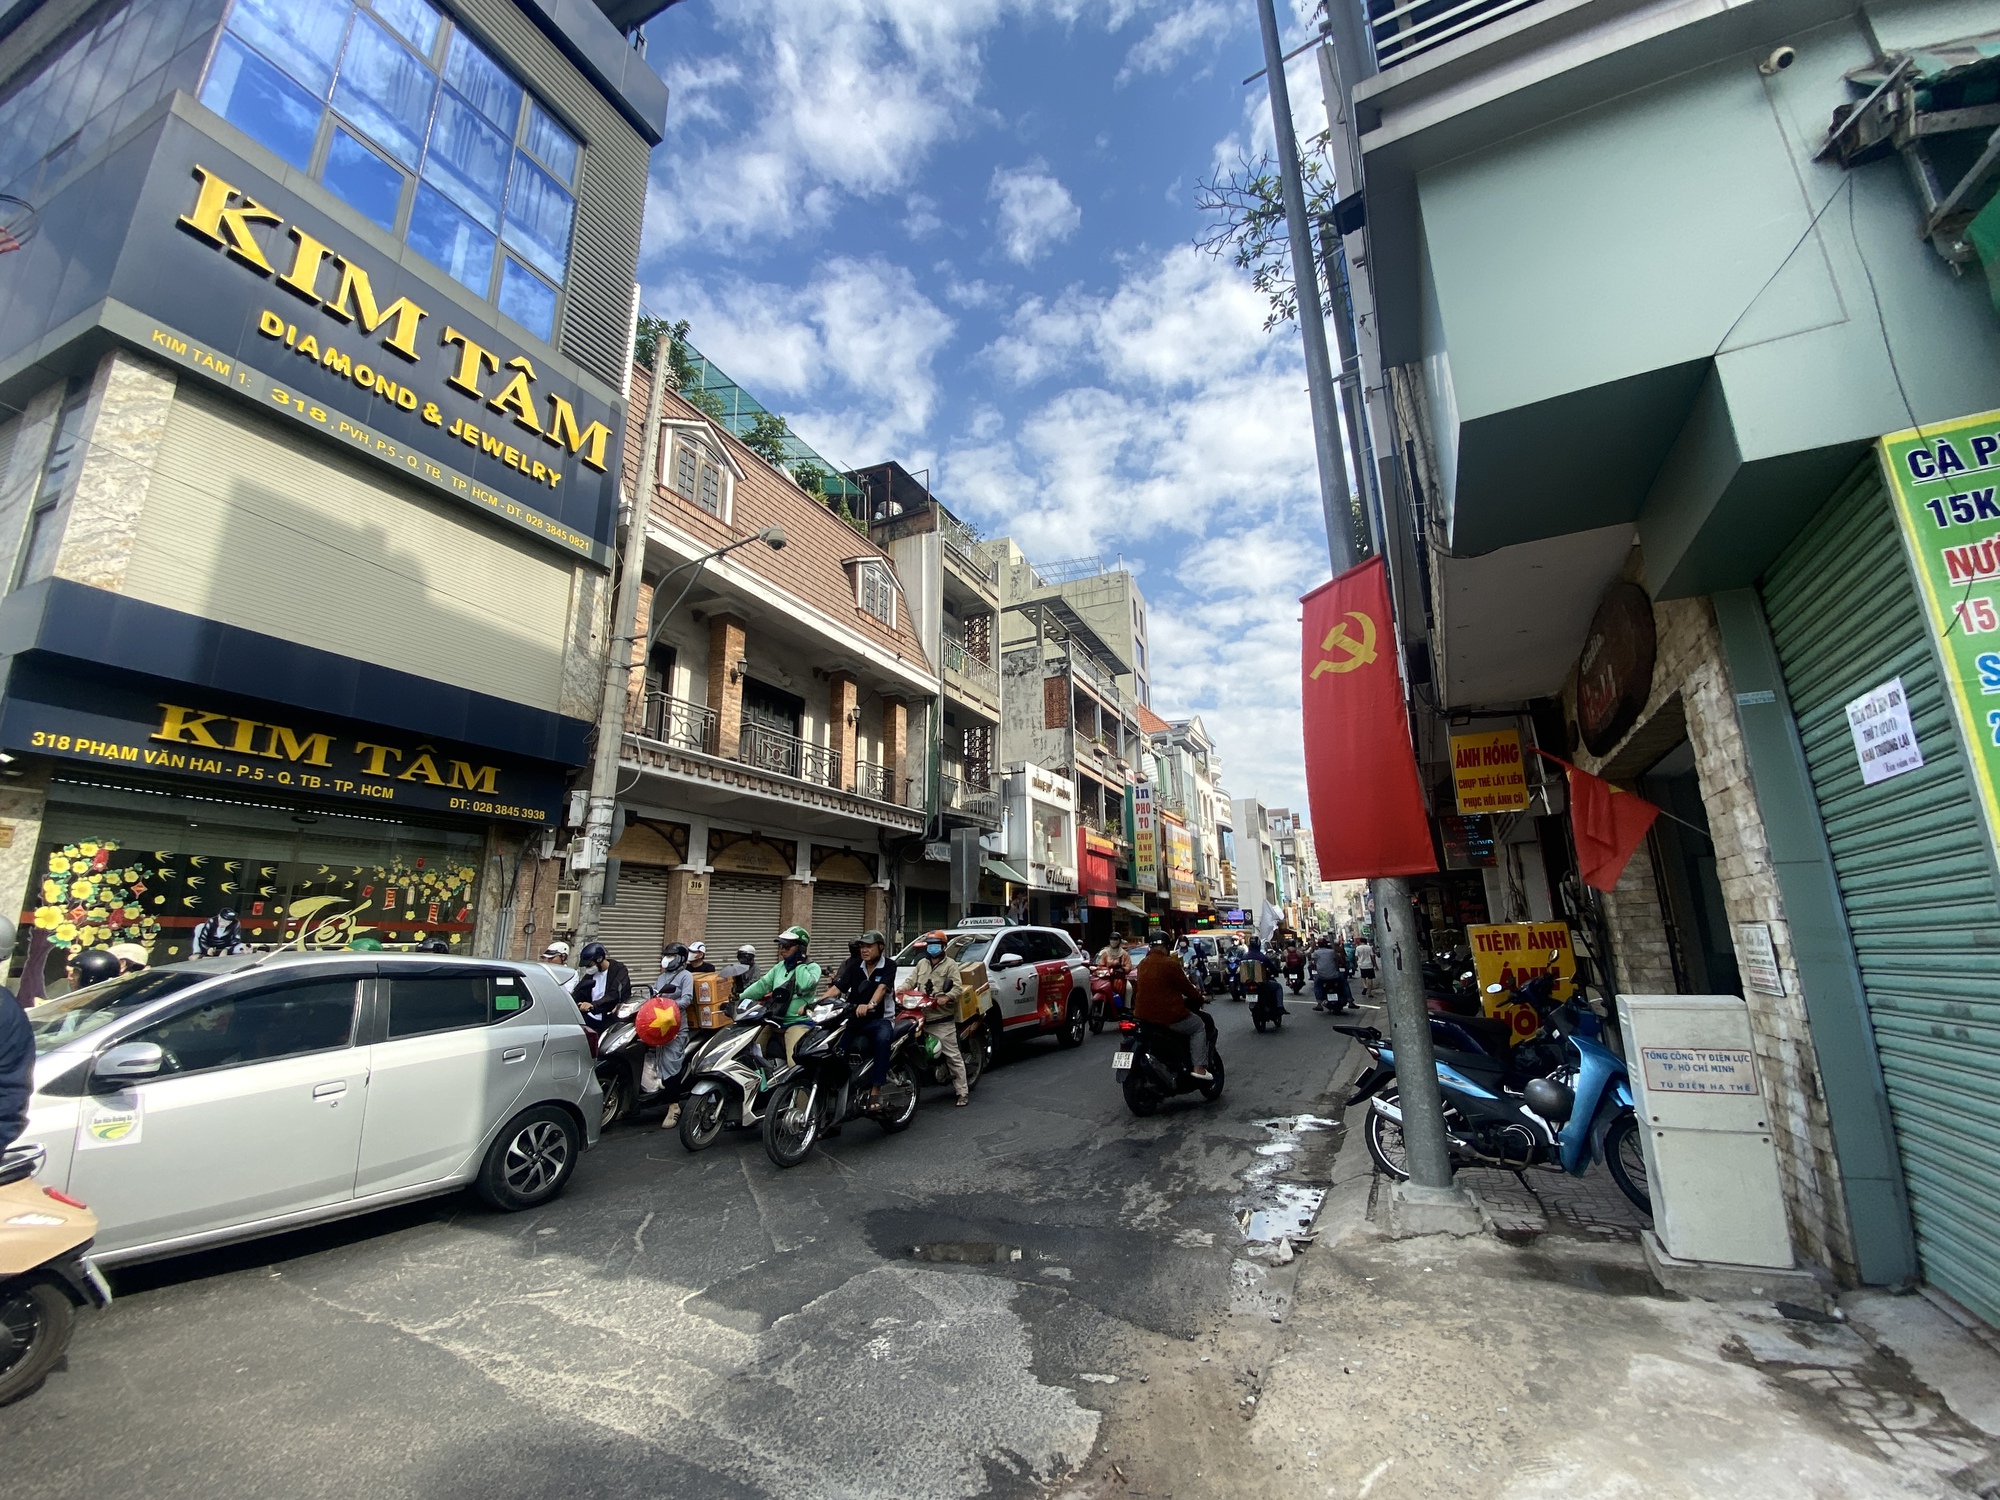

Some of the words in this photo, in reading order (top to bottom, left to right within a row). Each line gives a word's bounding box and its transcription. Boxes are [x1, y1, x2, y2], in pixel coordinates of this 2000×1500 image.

[178, 164, 428, 362] KIM
[442, 325, 614, 472] TÂM
[259, 309, 418, 411] DIAMOND
[422, 401, 442, 426] &
[449, 418, 562, 488] JEWELRY
[152, 329, 188, 356] KIM
[192, 346, 231, 377] TÂM
[339, 420, 372, 448] PVH,
[451, 475, 469, 493] TP.
[471, 485, 498, 507] HCM
[525, 512, 543, 529] 028
[545, 521, 568, 541] 3845
[568, 532, 590, 552] 0821
[1907, 438, 1965, 479] CÀ
[1971, 435, 2000, 466] P
[1926, 487, 2000, 528] 15K
[1944, 537, 2000, 580] NƯ
[150, 702, 337, 768] KIM
[353, 741, 502, 795] TÂM
[1455, 743, 1480, 768] ÁNH
[1482, 737, 1519, 766] HỒNG
[31, 731, 71, 751] 318
[74, 738, 139, 761] PHẠM
[143, 748, 186, 769] VĂN
[189, 757, 222, 774] HAI
[236, 764, 265, 781] P.5
[277, 771, 295, 785] Q.
[300, 774, 322, 788] TB
[333, 779, 357, 794] TP.
[360, 783, 394, 799] HCM
[1135, 786, 1149, 799] in
[449, 797, 471, 811] ĐT:
[472, 801, 493, 813] 028
[494, 803, 520, 818] 3845
[521, 808, 546, 821] 3938
[1135, 802, 1151, 815] PHO
[1138, 817, 1149, 829] TO
[690, 881, 702, 889] 316
[1475, 930, 1521, 955] TIỆM
[1527, 926, 1567, 950] ẢNH
[1663, 1063, 1676, 1072] TP.
[1711, 1065, 1735, 1073] MINH
[1670, 1051, 1694, 1061] CÔNG
[1696, 1053, 1706, 1061] TY
[1709, 1052, 1731, 1063] ĐIỆN
[1678, 1082, 1705, 1090] ĐIỆN
